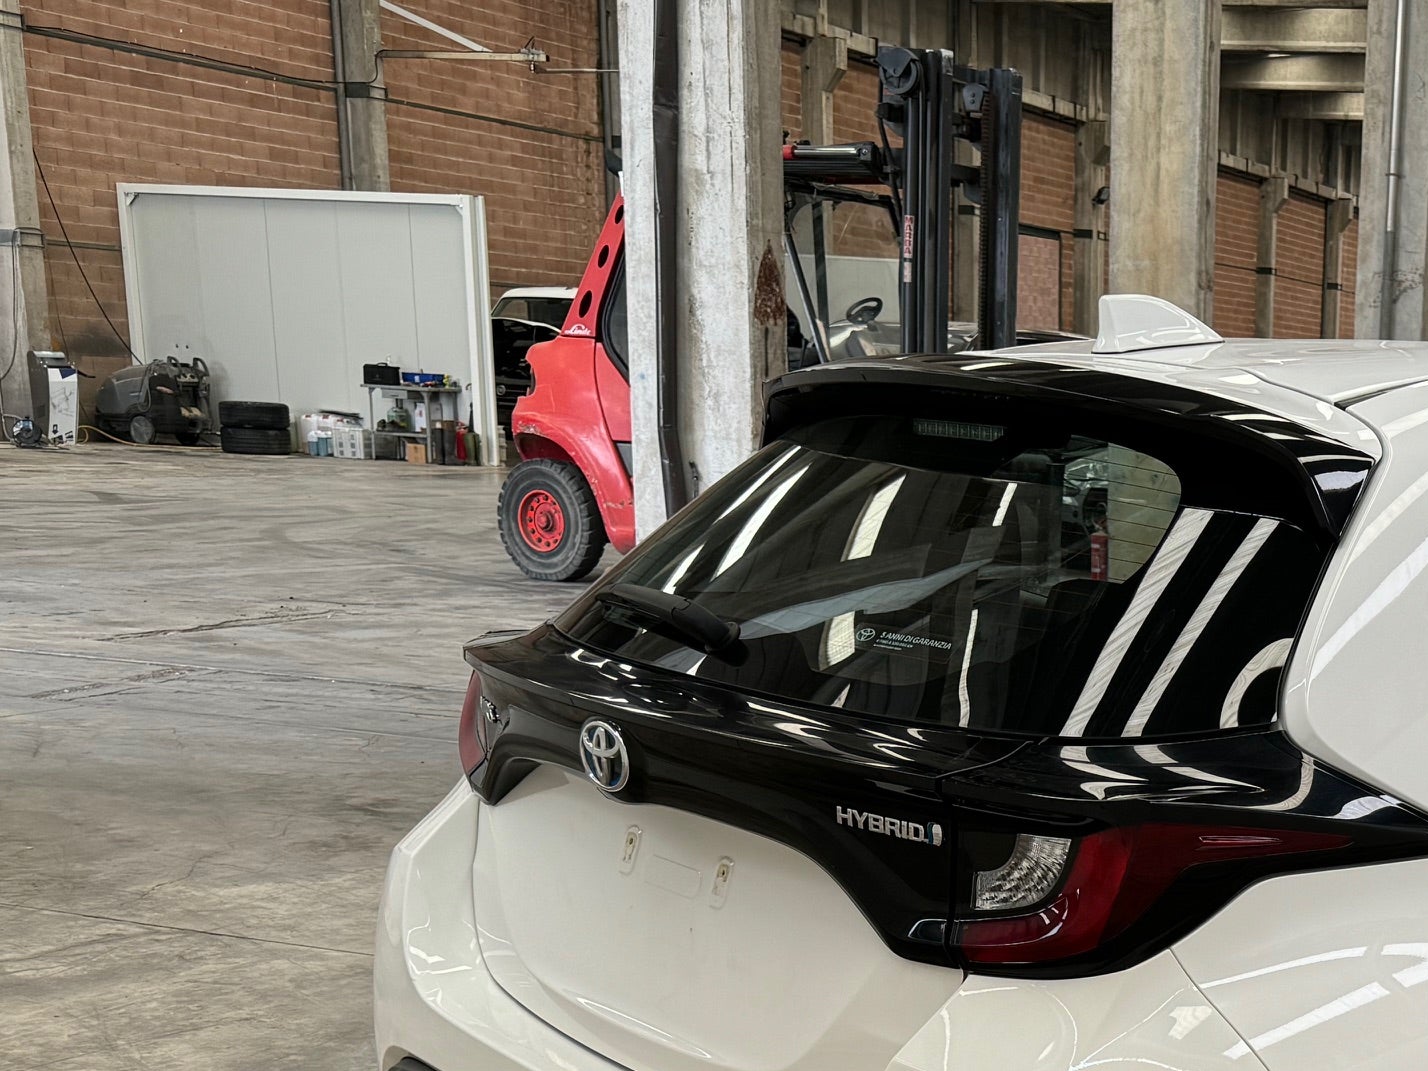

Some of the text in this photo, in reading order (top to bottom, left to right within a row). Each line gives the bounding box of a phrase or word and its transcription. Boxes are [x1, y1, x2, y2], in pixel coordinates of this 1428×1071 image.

[885, 632, 904, 641] ANNI
[904, 635, 914, 643] DI
[912, 636, 953, 650] GARANZIA
[835, 805, 925, 842] HYBRID
